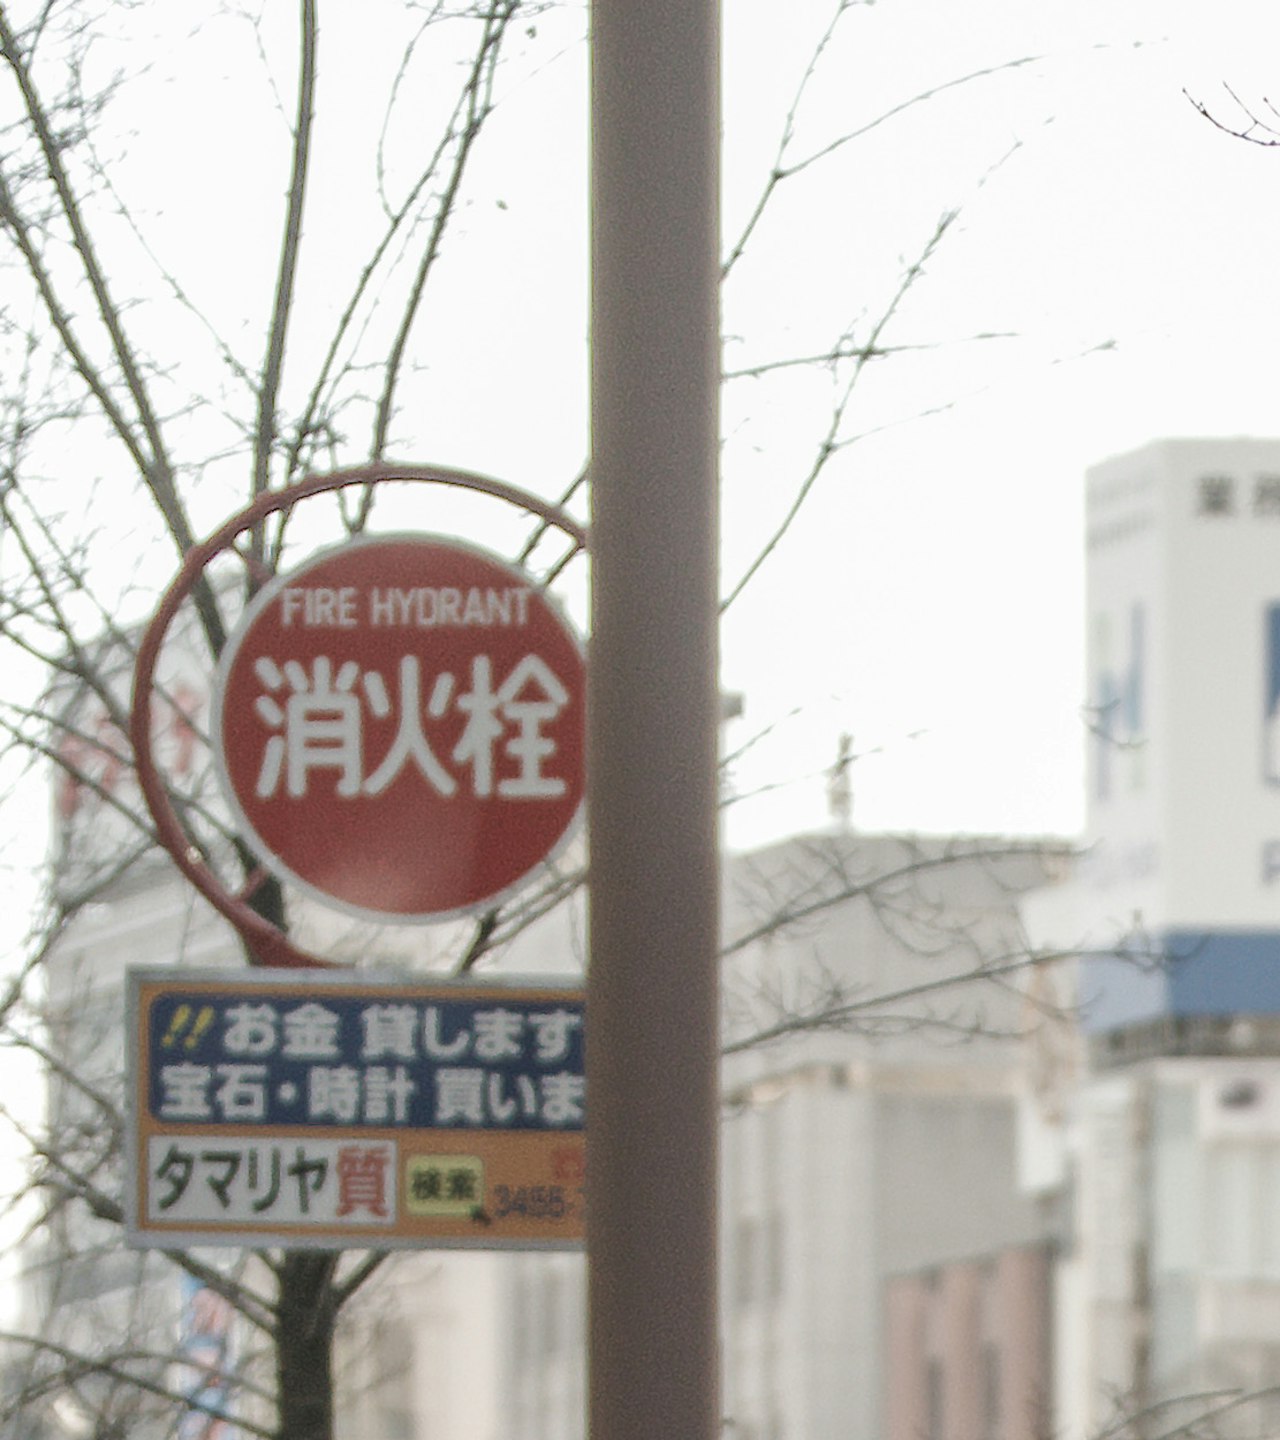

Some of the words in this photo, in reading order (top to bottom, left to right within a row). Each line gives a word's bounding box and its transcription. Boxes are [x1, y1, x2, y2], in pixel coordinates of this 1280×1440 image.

[281, 587, 357, 626] FIRE
[371, 586, 530, 627] HYDRANT
[254, 653, 568, 799] 消火栓
[223, 1003, 339, 1060] お金
[361, 1005, 583, 1062] 貸します
[159, 1062, 414, 1122] 宝石・時計
[156, 1145, 390, 1220] タマリヤ質
